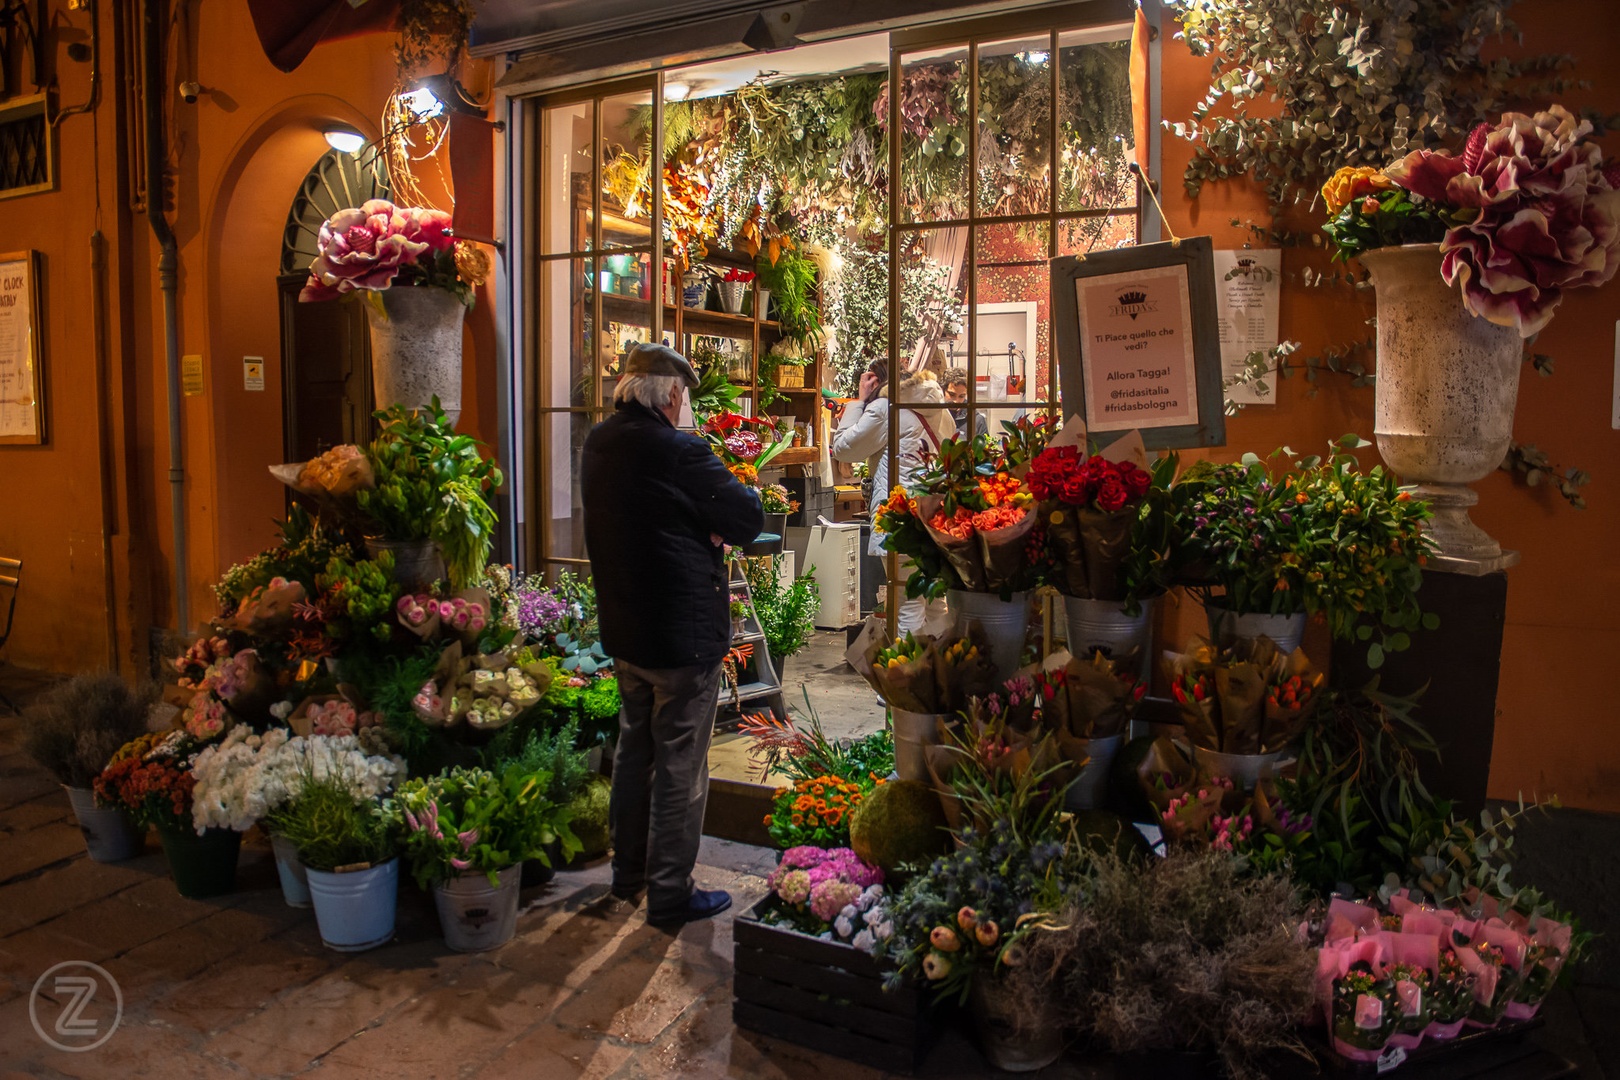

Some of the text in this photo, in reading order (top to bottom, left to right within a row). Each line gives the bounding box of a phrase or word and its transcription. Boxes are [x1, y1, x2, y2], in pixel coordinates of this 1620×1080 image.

[4, 276, 24, 291] CLOCK
[1095, 328, 1174, 343] Ti Piace quello che
[1125, 341, 1148, 351] vedi?
[1106, 366, 1170, 381] Allora Tagga!
[1110, 386, 1169, 399] @fridasitalia
[1105, 400, 1178, 412] #fridasbologna
